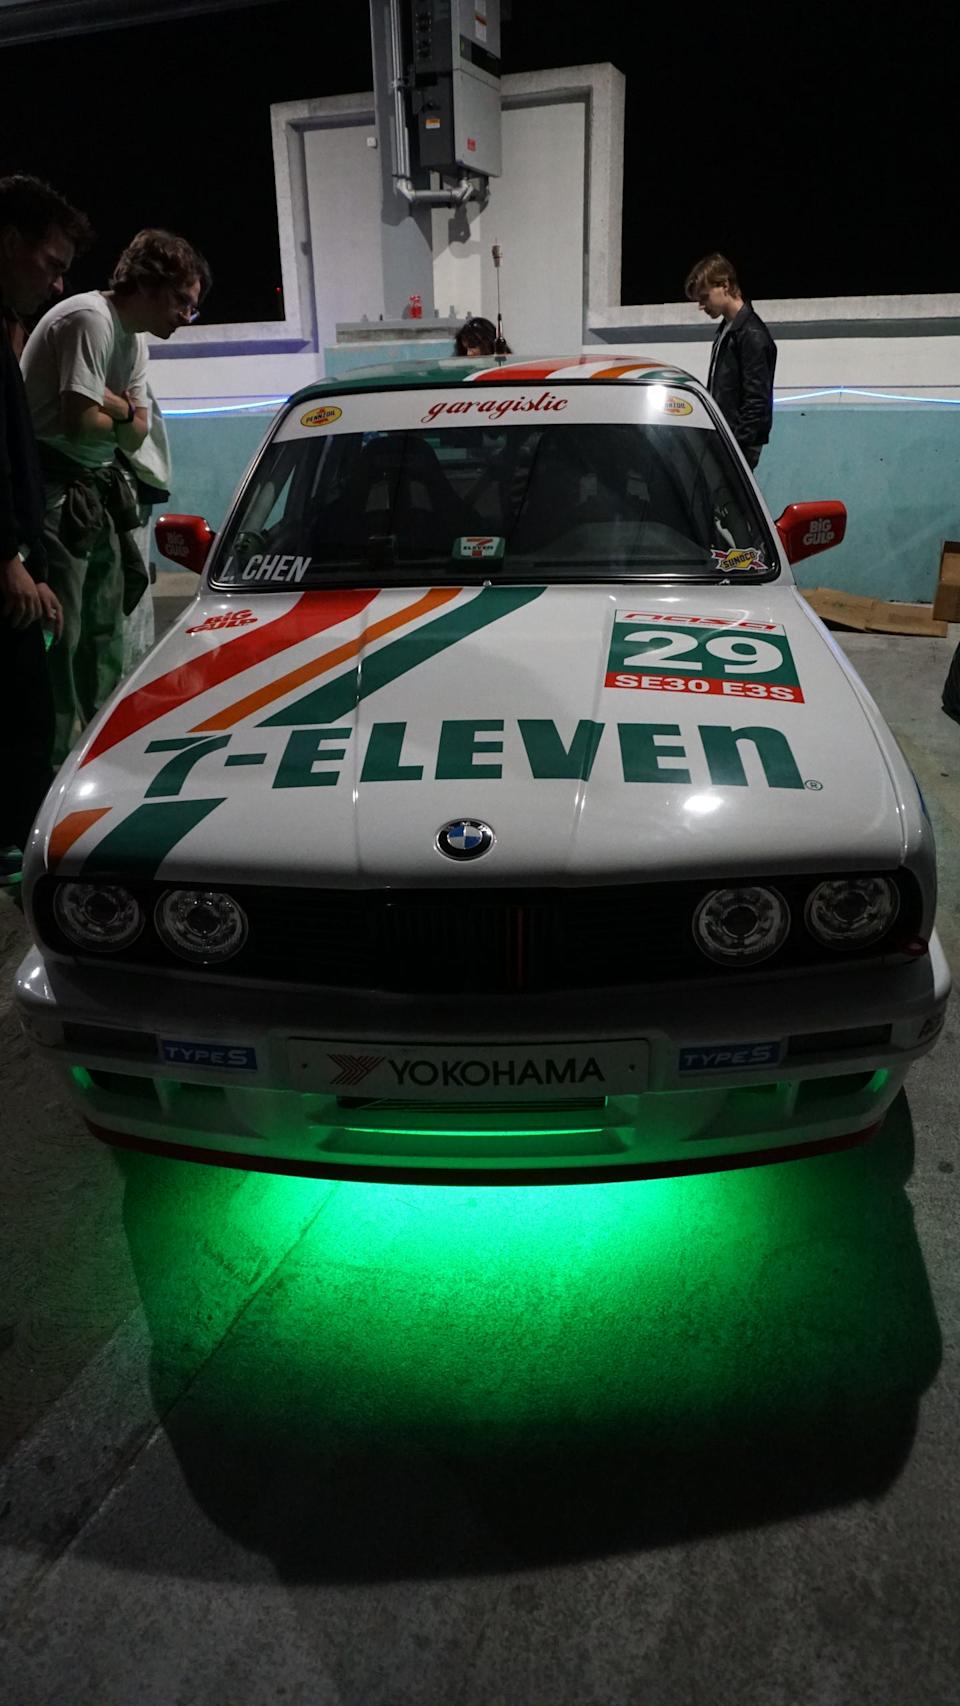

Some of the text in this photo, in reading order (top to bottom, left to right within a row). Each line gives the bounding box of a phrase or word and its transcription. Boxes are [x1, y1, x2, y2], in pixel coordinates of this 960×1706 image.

[421, 391, 568, 424] garagistic
[803, 531, 835, 546] GULP
[242, 554, 312, 583] CHEN
[722, 550, 757, 569] SUNOCO
[186, 618, 258, 633] GULP
[623, 630, 784, 674] 29
[614, 674, 795, 701] SE30 E3S
[387, 1057, 605, 1087] YOKOHAMA
